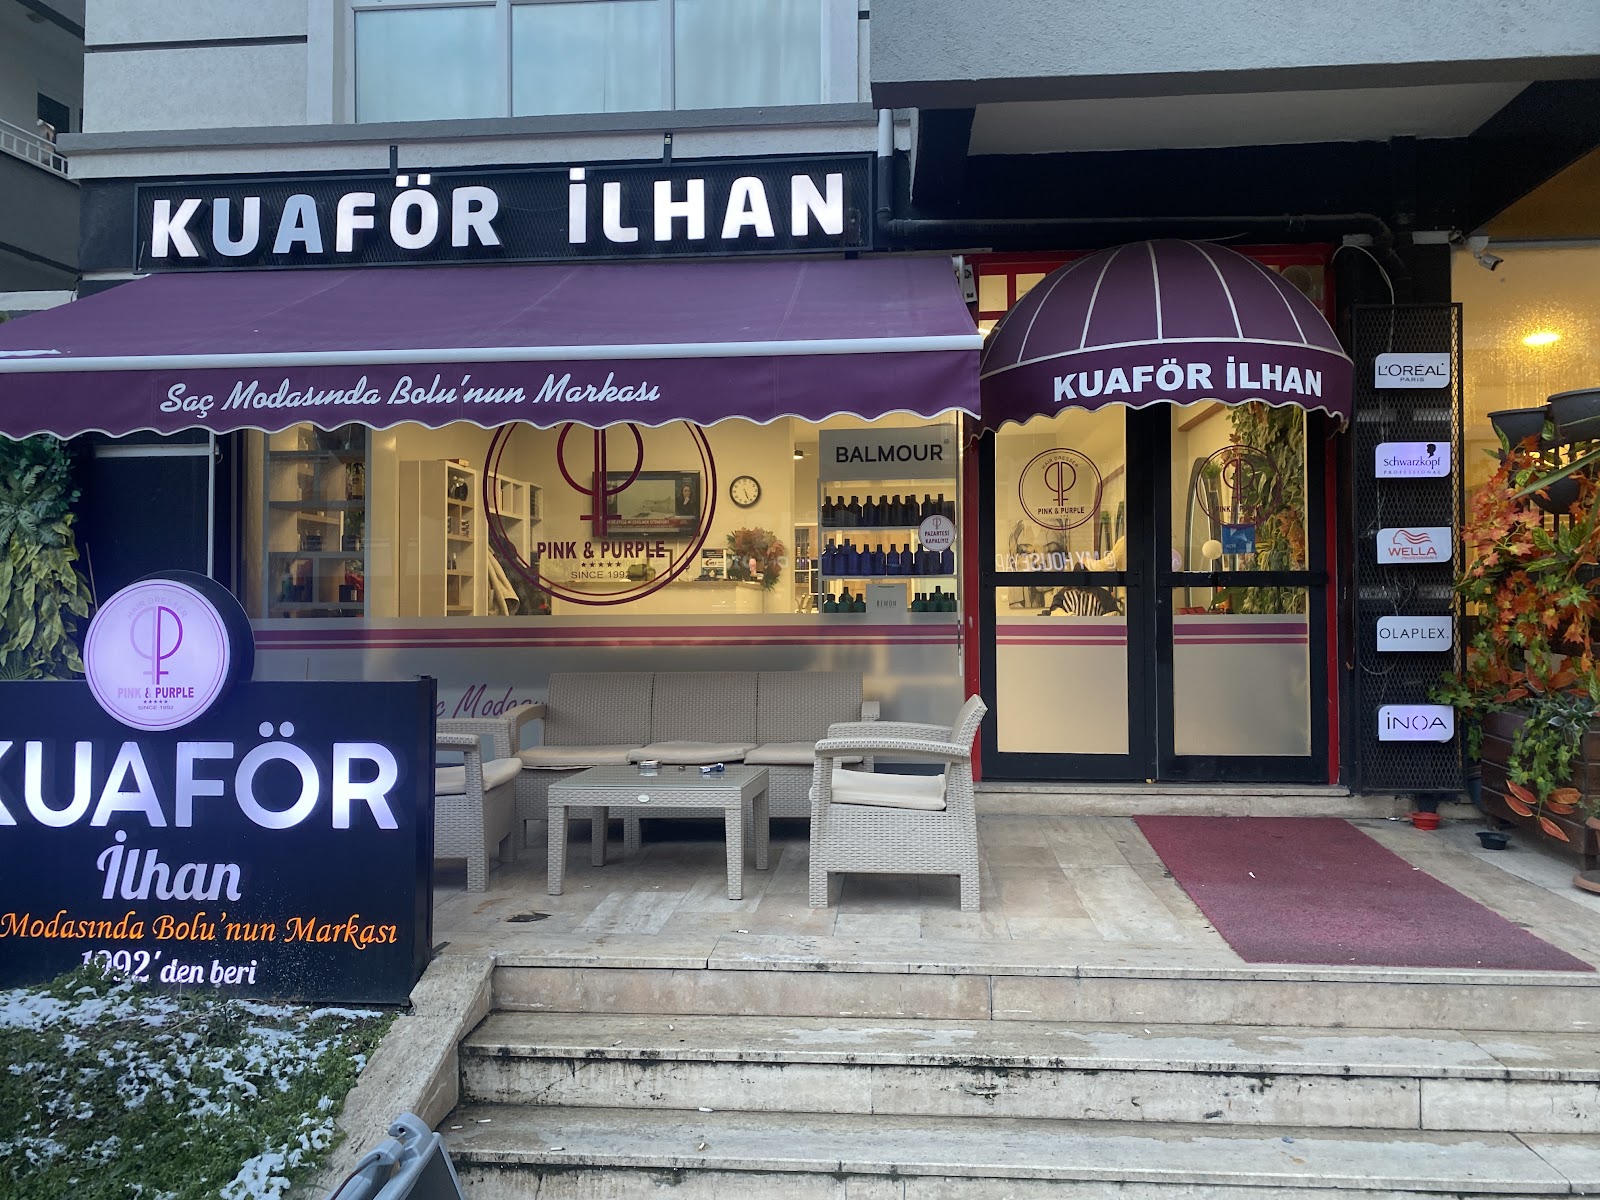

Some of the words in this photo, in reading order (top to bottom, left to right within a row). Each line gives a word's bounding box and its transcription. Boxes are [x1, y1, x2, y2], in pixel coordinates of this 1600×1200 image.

[151, 174, 501, 258] KUAFÖR
[568, 167, 844, 244] İLHAN
[1053, 358, 1213, 402] KUAFÖR
[1226, 355, 1322, 398] İLHAN
[159, 383, 215, 419] Saç
[220, 375, 382, 411] Modasında
[387, 373, 526, 405] Bolu'nun
[532, 371, 661, 404] Markası
[835, 443, 944, 463] BALMOUR
[1383, 456, 1442, 470] Schwarzkopf
[1037, 507, 1053, 515] PINK
[1060, 506, 1085, 514] PURPLE
[537, 541, 577, 560] PINK
[583, 541, 595, 559] &
[600, 540, 666, 559] PURPLE
[1388, 547, 1438, 556] WELLA
[571, 571, 604, 579] SINCE
[117, 687, 141, 698] PINK
[155, 687, 194, 698] PURPLE
[0, 721, 399, 829] UAFÖR
[97, 830, 242, 901] İlhan
[0, 909, 145, 940] Modasında
[152, 912, 277, 942] Bolu'nun
[284, 914, 398, 950] Markası
[209, 959, 258, 985] beri
